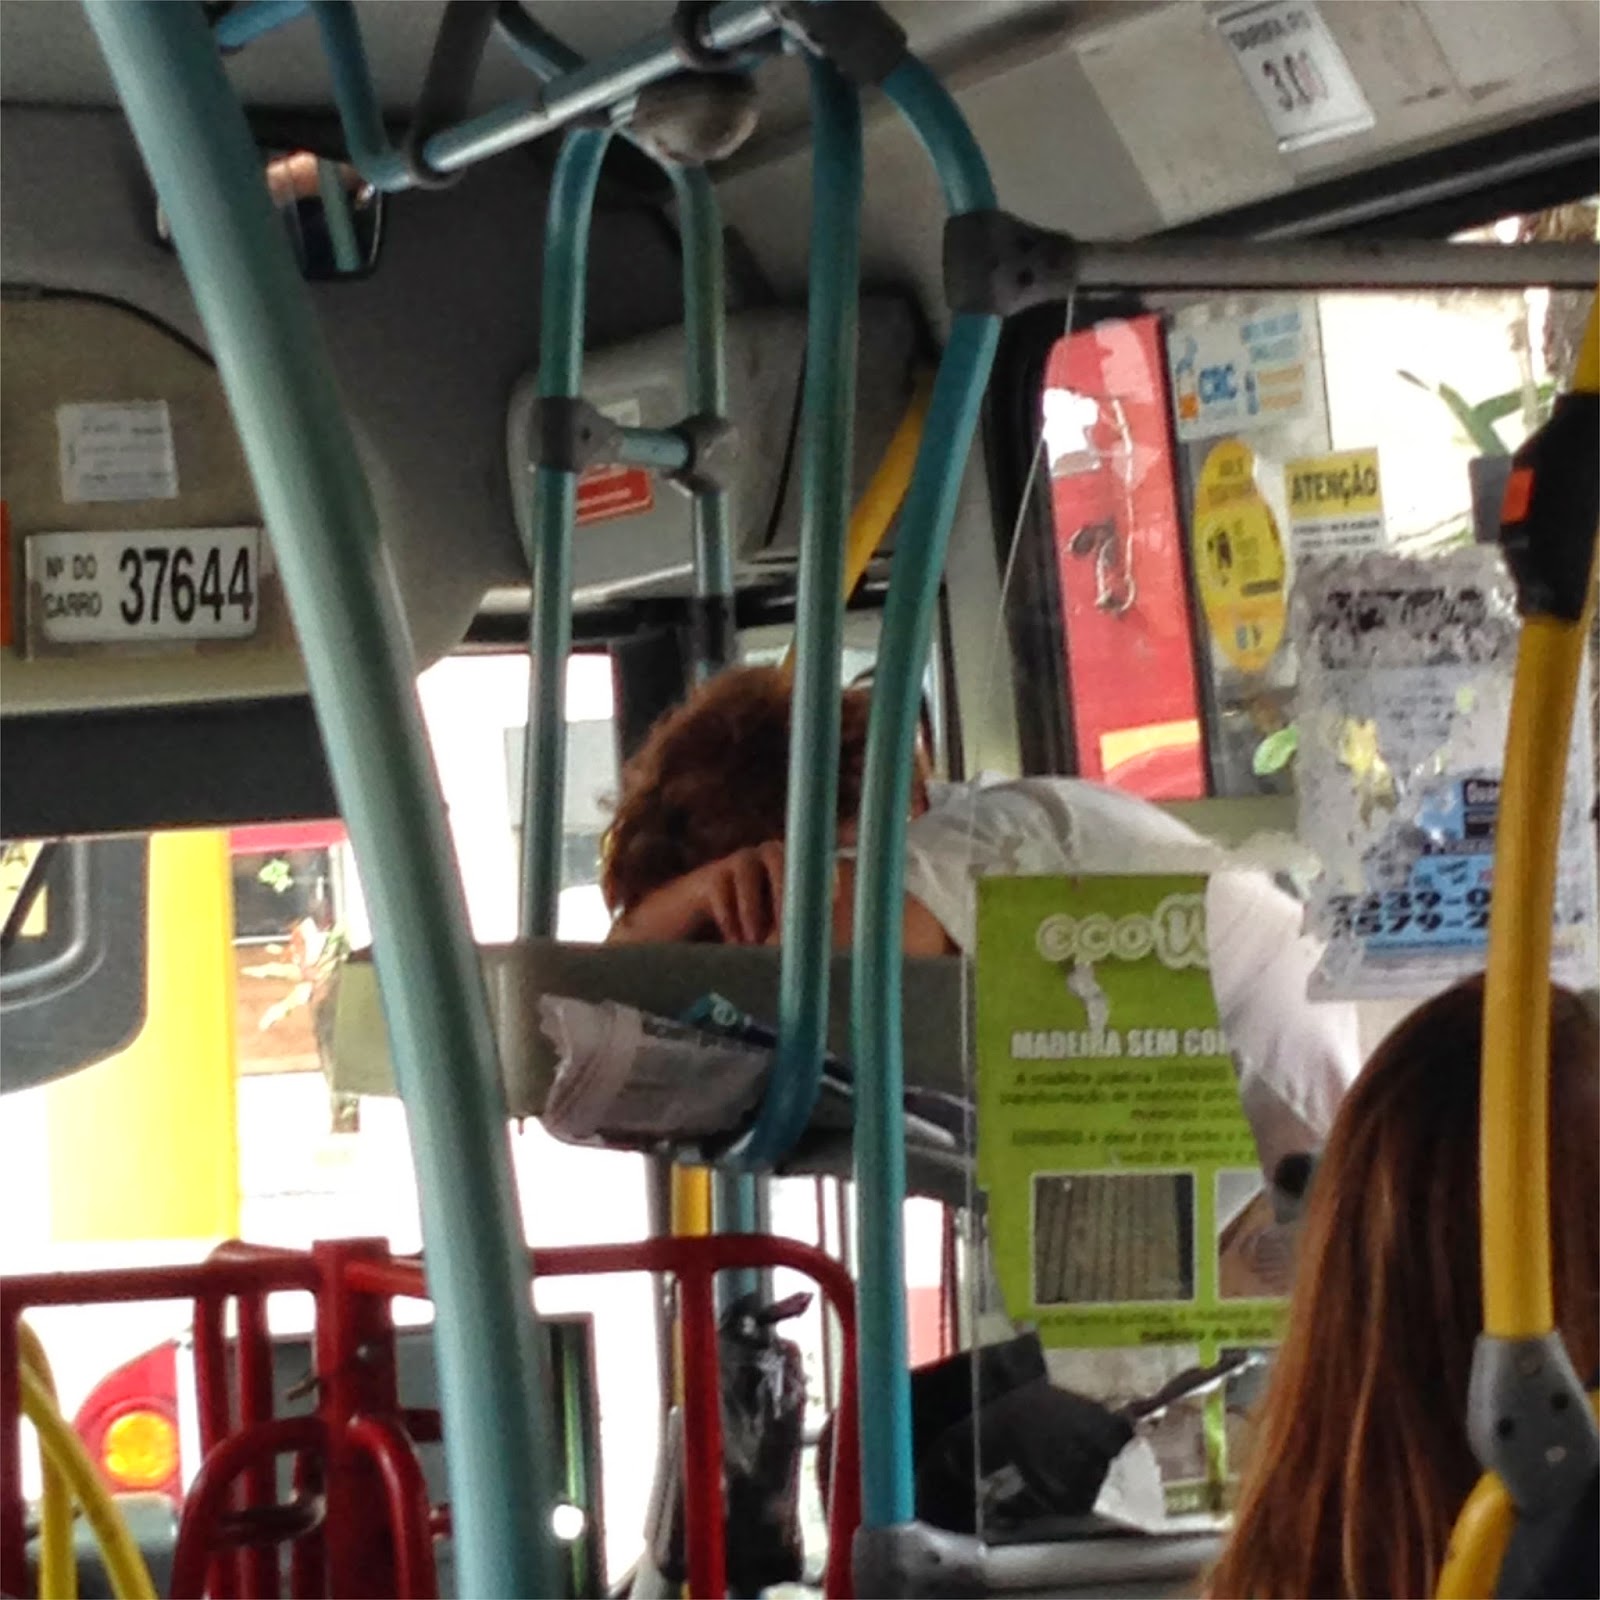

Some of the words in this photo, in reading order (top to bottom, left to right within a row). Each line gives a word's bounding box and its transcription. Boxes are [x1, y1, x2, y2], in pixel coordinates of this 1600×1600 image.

[1291, 461, 1378, 507] ATENÇÃO
[73, 554, 98, 580] DO
[119, 546, 254, 625] 37644
[44, 591, 103, 619] CARRO
[1011, 1029, 1122, 1059] MADEIRA
[1127, 1028, 1179, 1057] SEM
